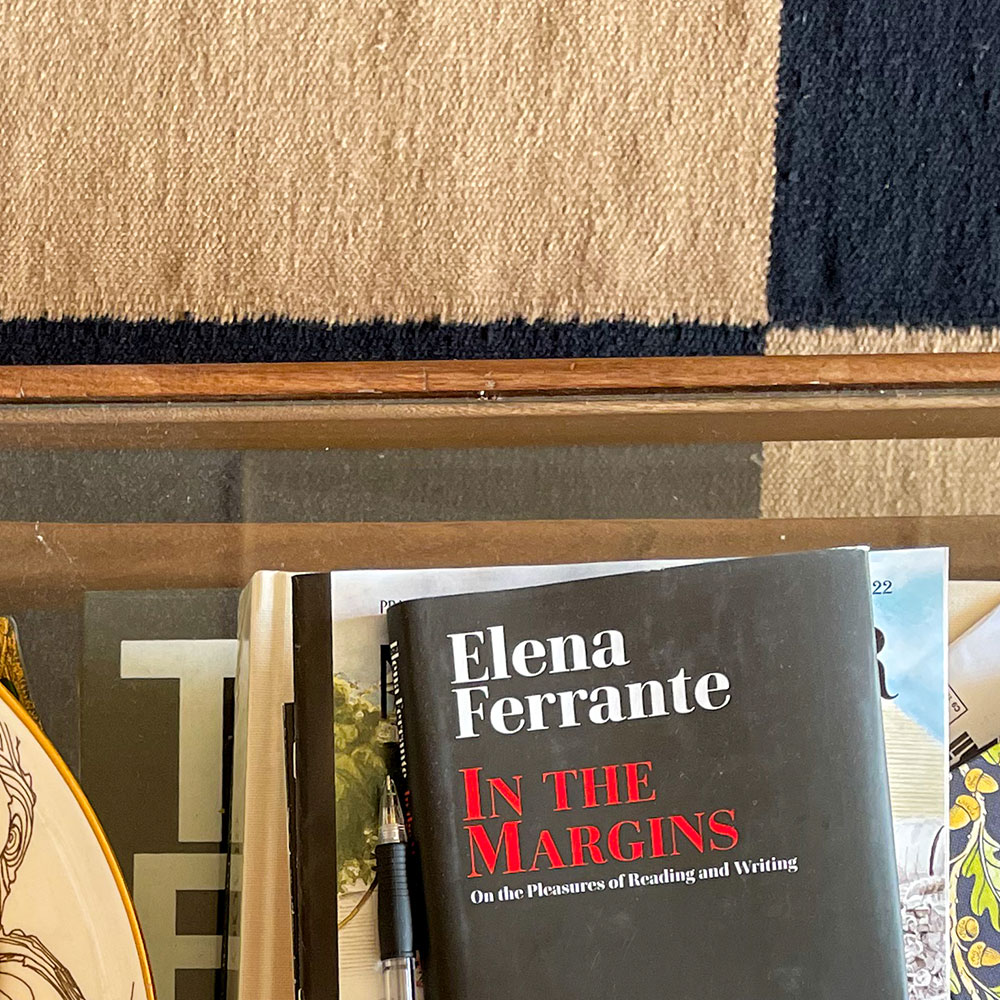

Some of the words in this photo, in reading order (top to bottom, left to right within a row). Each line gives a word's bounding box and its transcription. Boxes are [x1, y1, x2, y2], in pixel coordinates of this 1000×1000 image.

[446, 625, 631, 686] Elena
[452, 667, 731, 740] Ferrante
[470, 889, 495, 904] On
[497, 885, 524, 901] the
[526, 878, 606, 898] Pleasures
[608, 873, 626, 890] of
[628, 868, 696, 887] Reading
[698, 861, 730, 880] and
[733, 856, 799, 875] Writing
